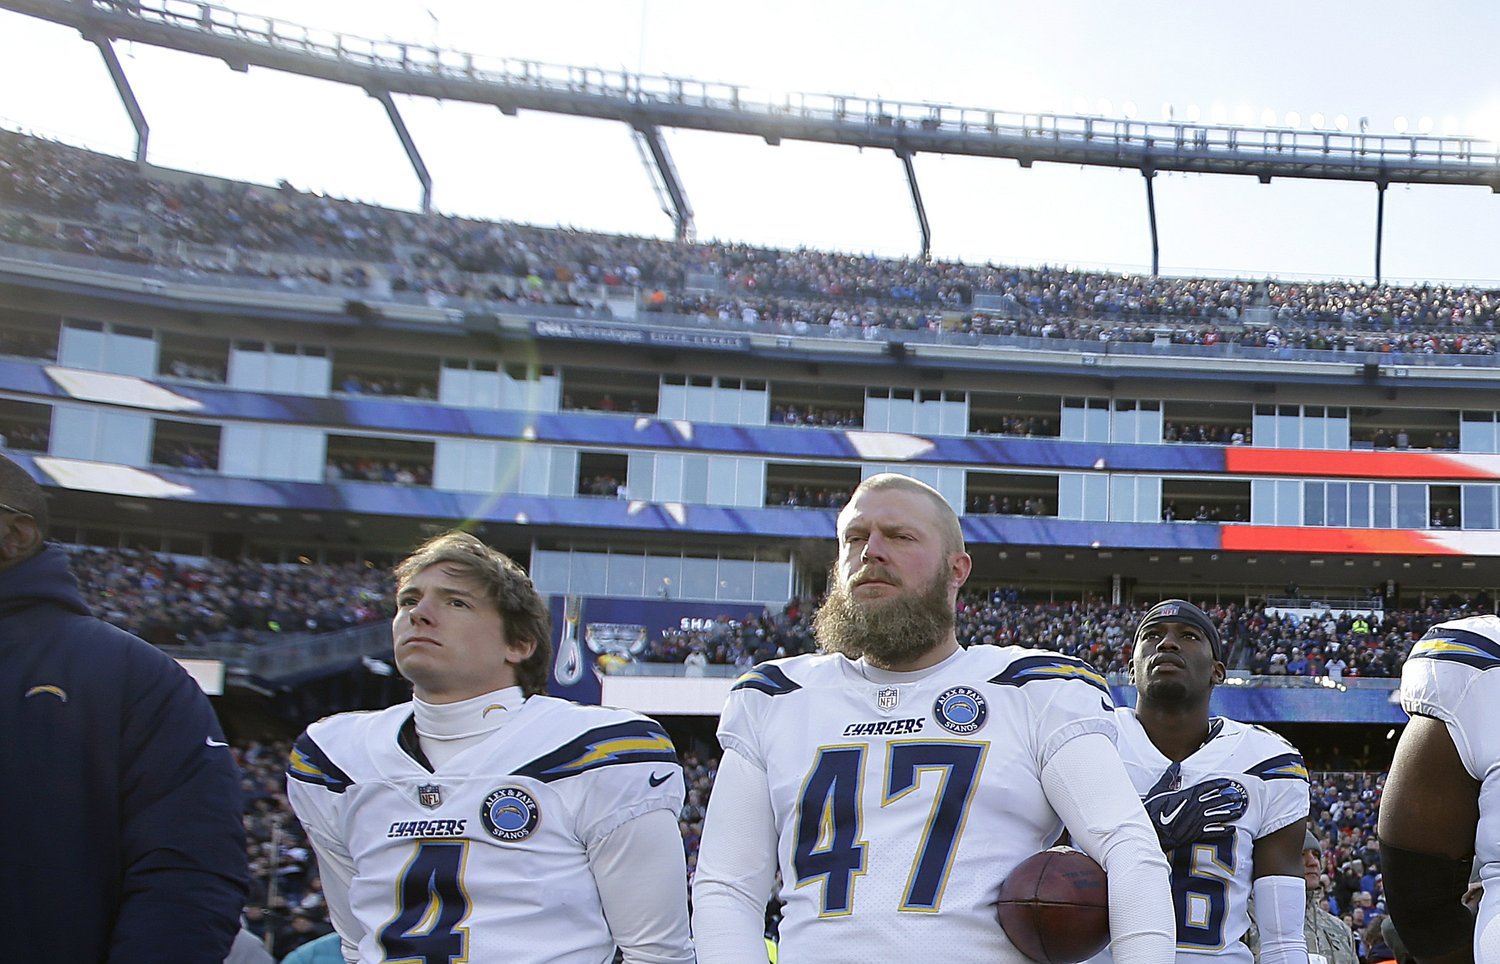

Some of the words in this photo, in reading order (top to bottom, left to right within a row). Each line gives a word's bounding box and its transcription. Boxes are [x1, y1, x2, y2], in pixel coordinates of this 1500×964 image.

[843, 717, 926, 737] CHARGERS
[944, 720, 978, 733] SPANOS
[485, 789, 507, 808] ALEX
[515, 791, 536, 810] FAYE
[386, 819, 468, 838] CHARGERS
[492, 828, 530, 840] SPANOS
[790, 737, 992, 919] 47
